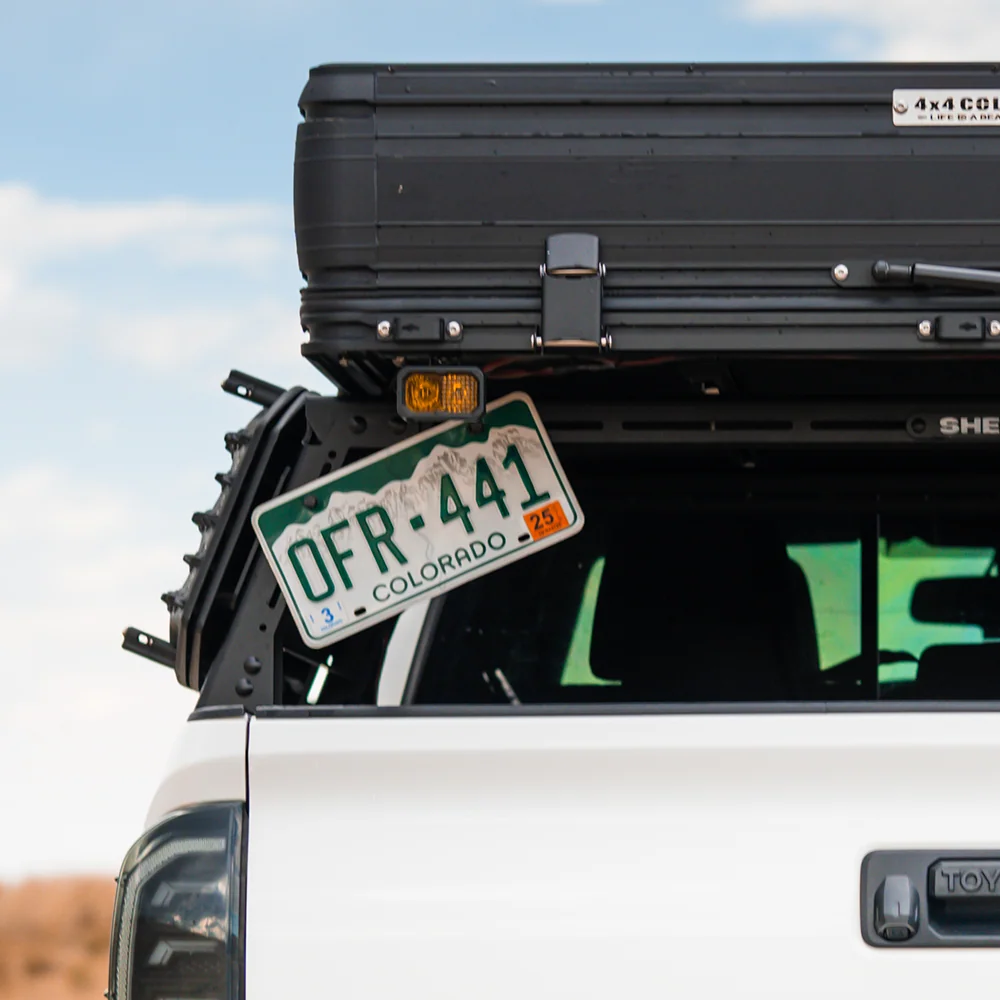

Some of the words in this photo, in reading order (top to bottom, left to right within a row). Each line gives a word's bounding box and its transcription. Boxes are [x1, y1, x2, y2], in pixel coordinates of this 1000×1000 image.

[914, 97, 955, 112] 4x4
[930, 113, 954, 121] LIFE
[970, 113, 978, 121] A
[530, 507, 554, 530] 25
[372, 532, 507, 602] COLORADO
[321, 607, 335, 624] 3
